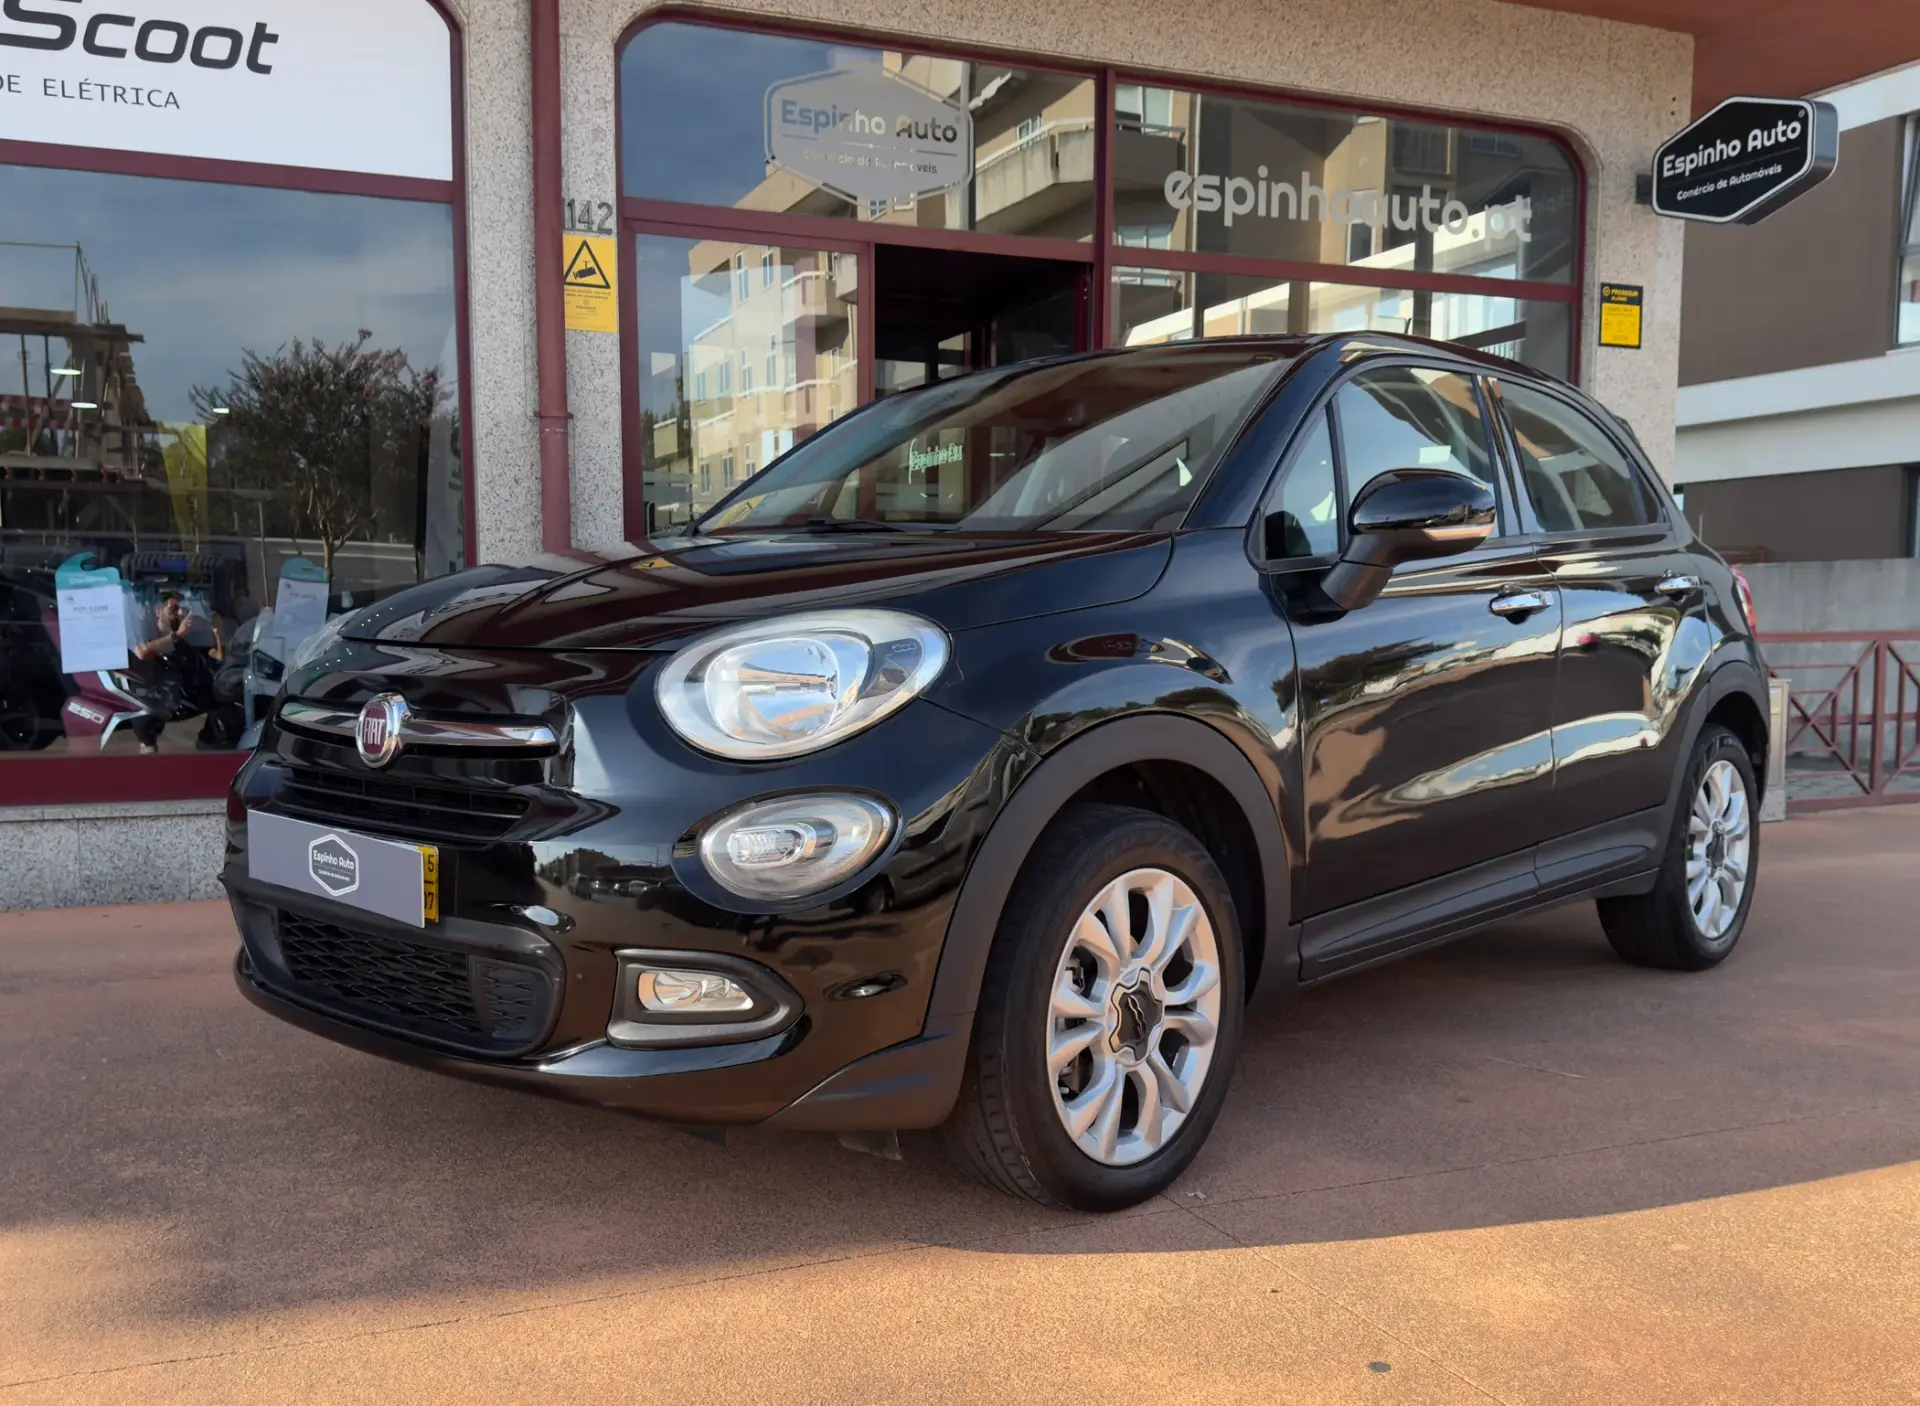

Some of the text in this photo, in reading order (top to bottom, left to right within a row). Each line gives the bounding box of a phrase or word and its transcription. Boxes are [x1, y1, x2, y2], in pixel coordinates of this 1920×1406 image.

[0, 75, 180, 110] E ELÉTRICA
[781, 100, 958, 144] Espinho Auto
[1662, 119, 1802, 178] Espinho Auto
[1676, 163, 1783, 201] Comércio de Automóveis
[567, 198, 613, 235] 142
[1164, 165, 1532, 250] espinhoauto.pt
[67, 702, 105, 725] 250
[363, 717, 385, 745] FIAT
[313, 849, 355, 870] Espinho Auto
